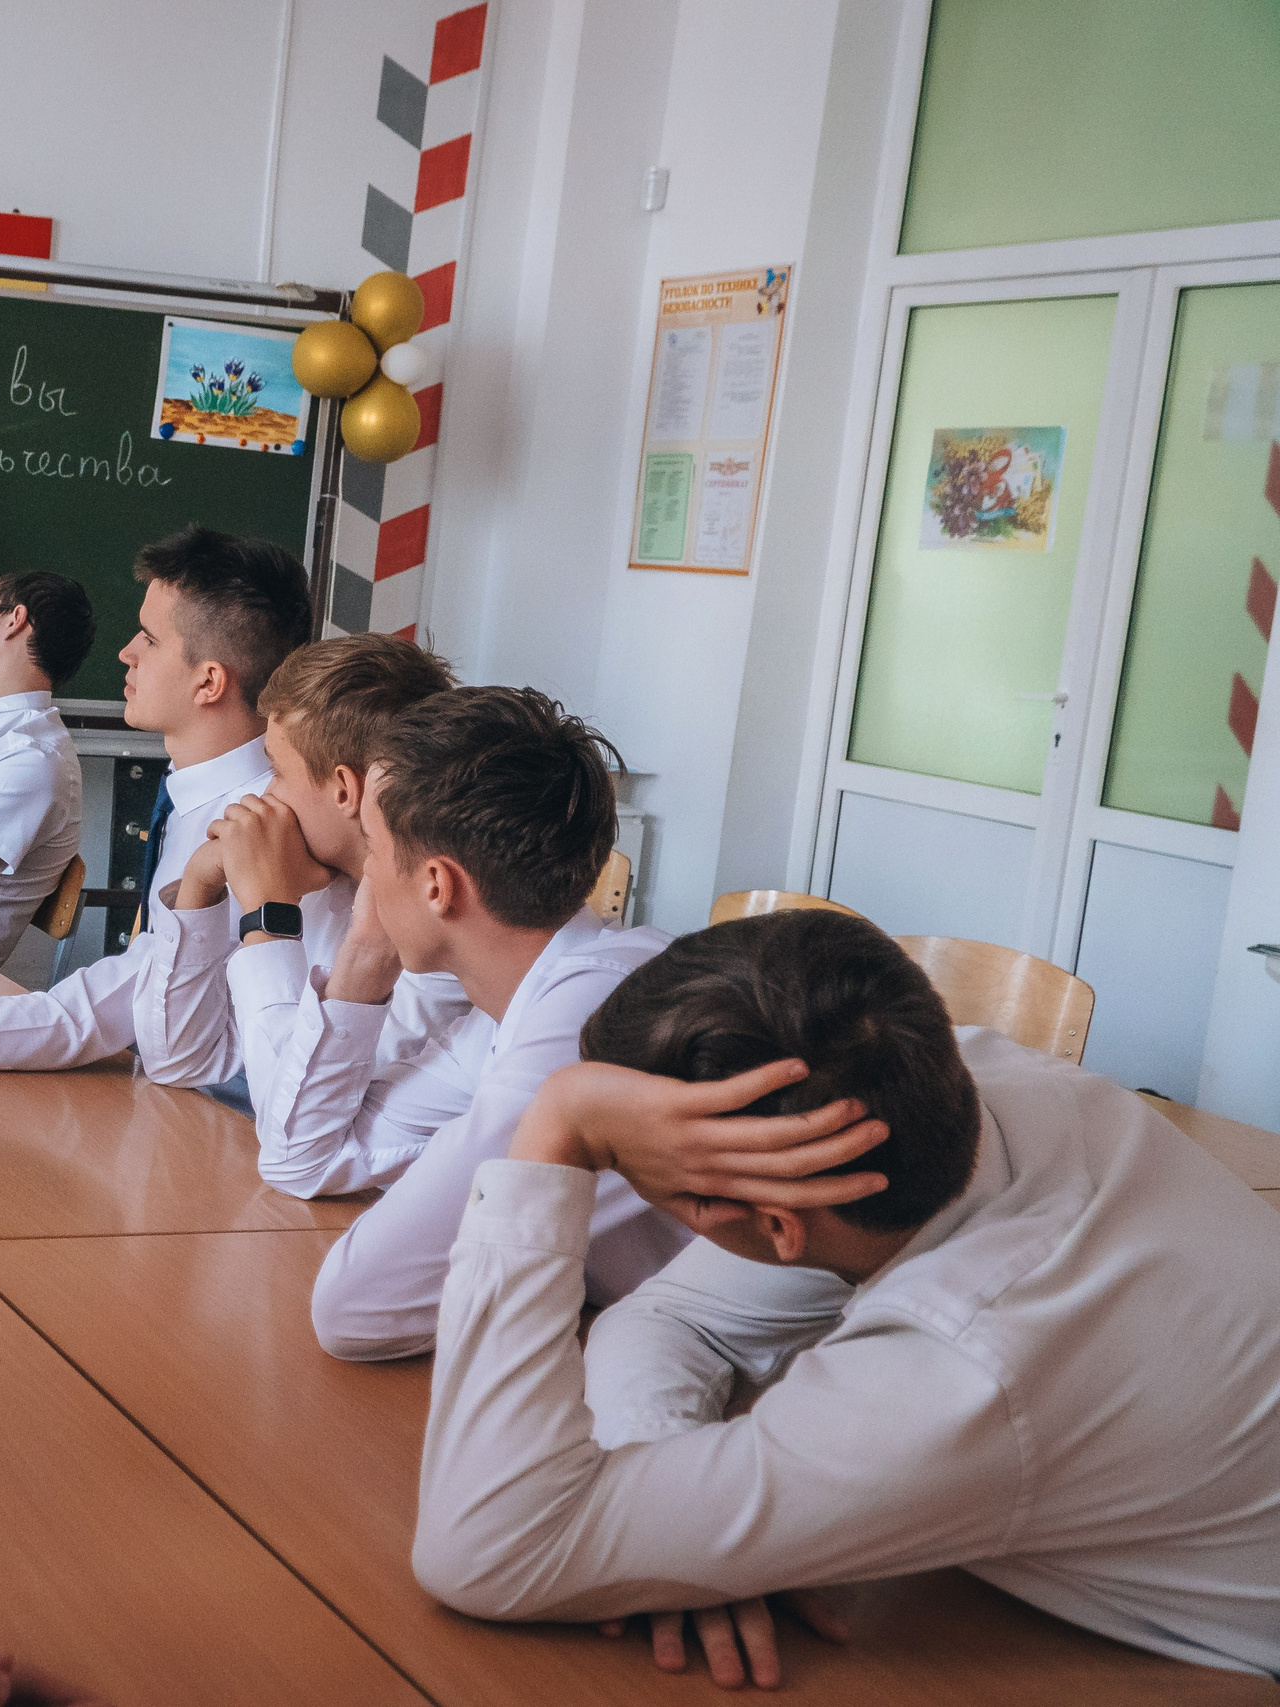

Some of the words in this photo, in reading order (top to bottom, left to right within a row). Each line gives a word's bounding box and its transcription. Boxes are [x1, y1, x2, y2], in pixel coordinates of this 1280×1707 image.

[701, 282, 714, 295] ПО
[716, 277, 758, 293] ТЕХНИКЕ
[663, 296, 733, 315] БЕЗОПАСНОСТИ
